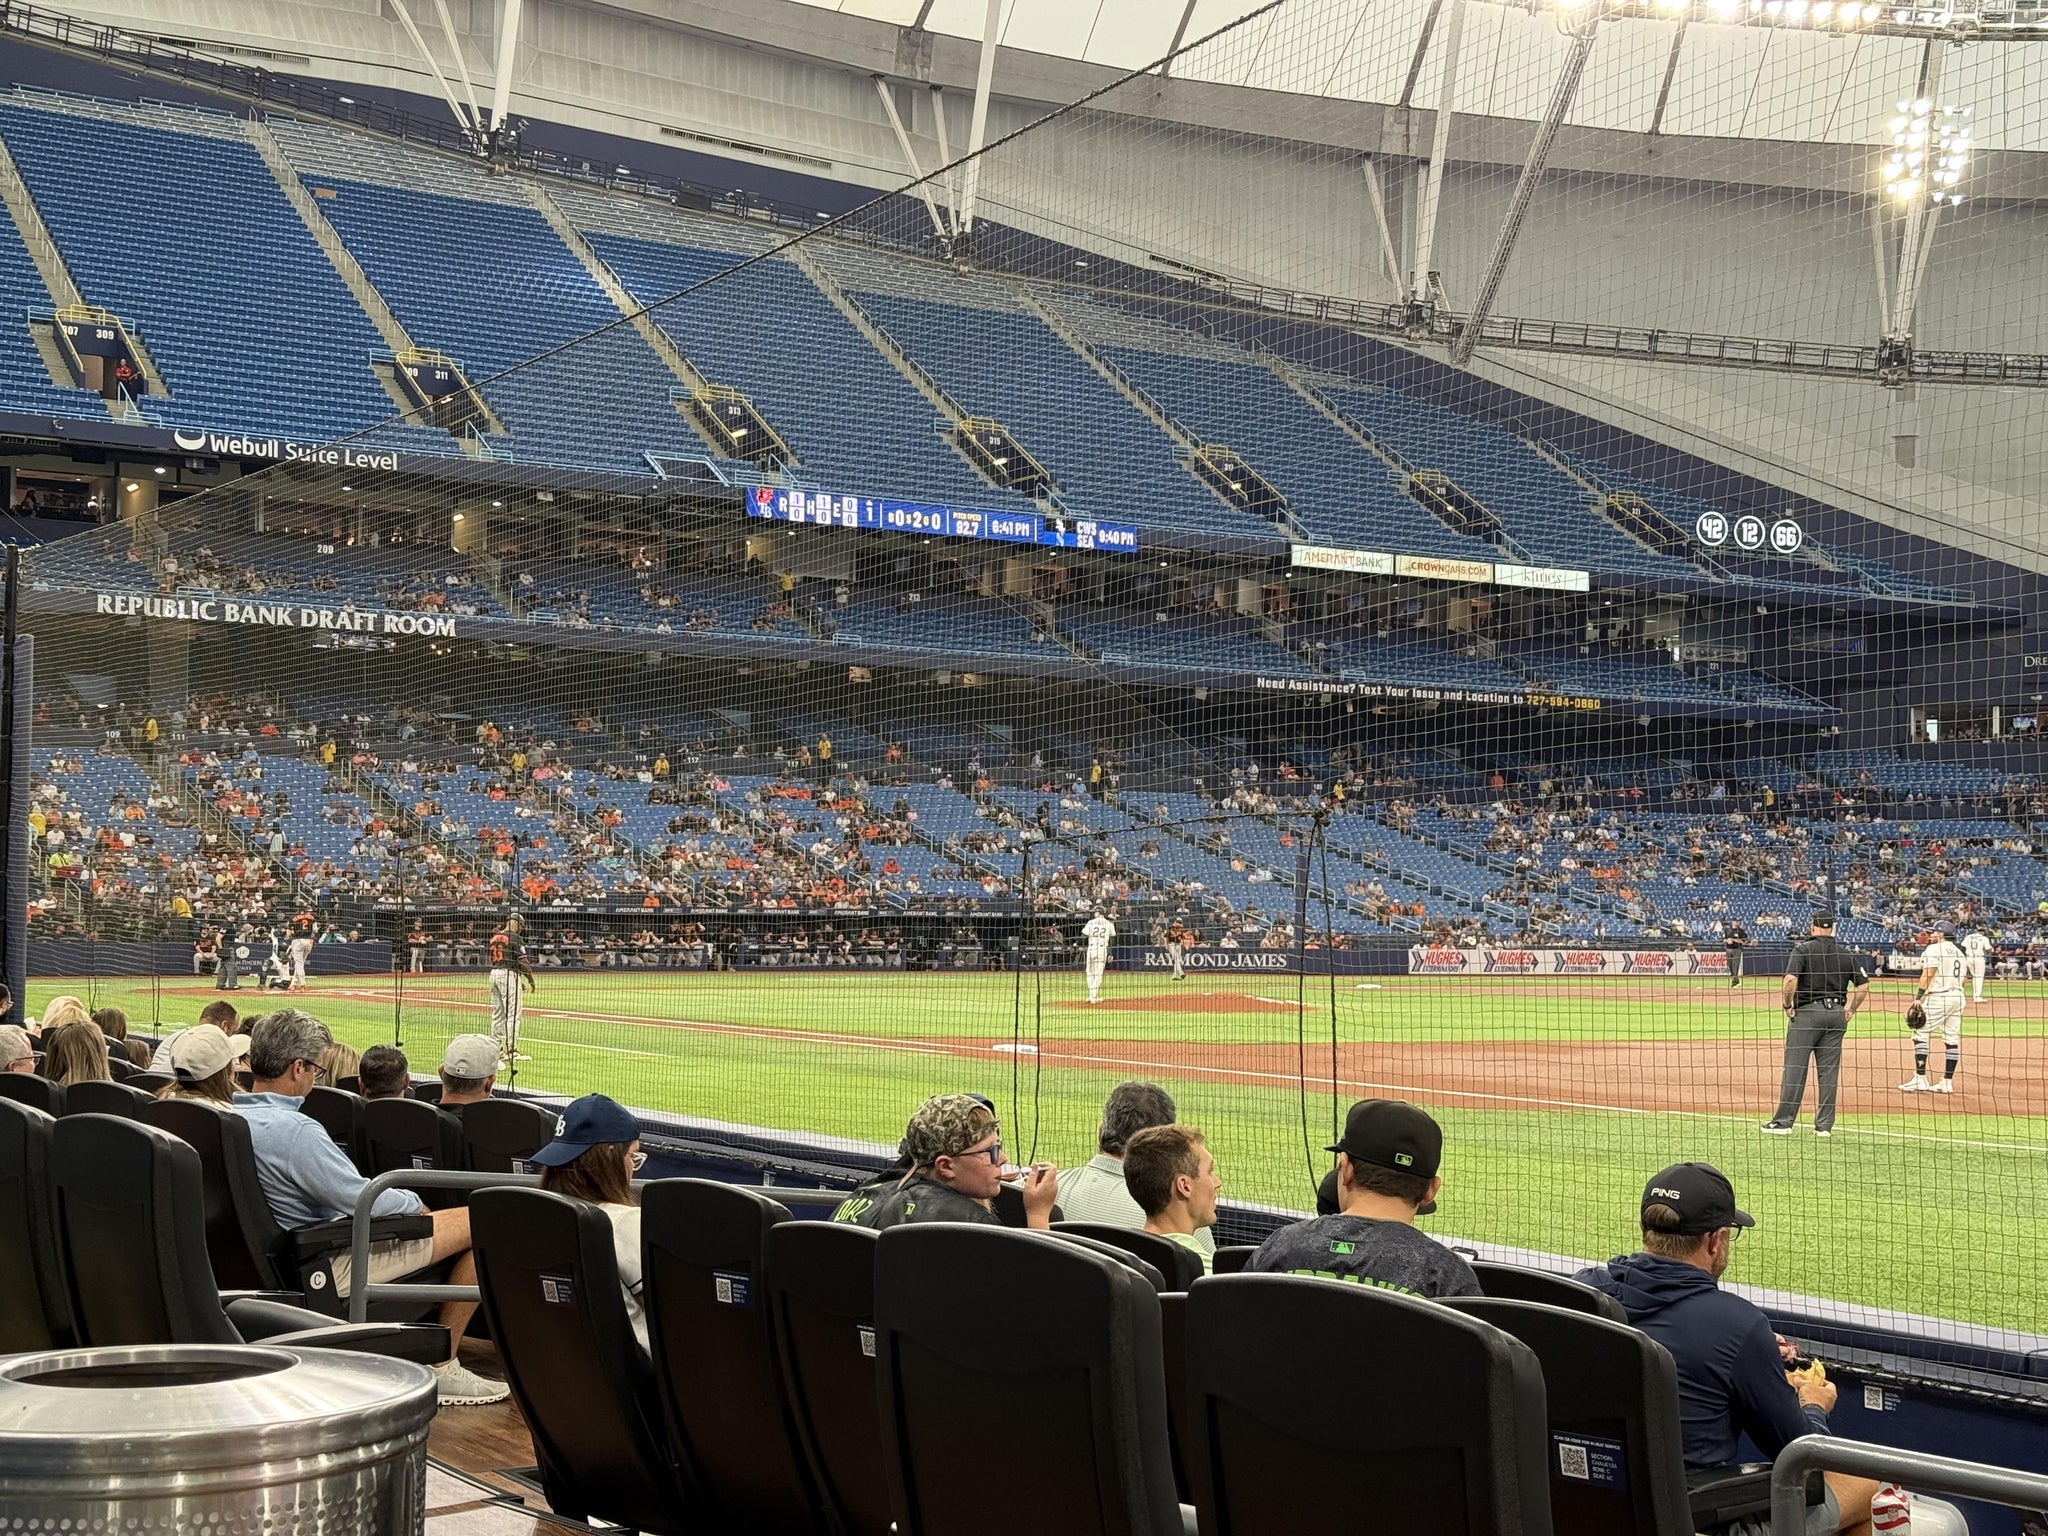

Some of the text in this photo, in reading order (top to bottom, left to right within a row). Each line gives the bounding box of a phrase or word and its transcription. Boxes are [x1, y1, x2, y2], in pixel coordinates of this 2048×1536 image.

[96, 328, 114, 340] 309
[435, 370, 448, 380] 311
[728, 406, 740, 416] 313
[210, 434, 398, 470] Webull Suite Level
[779, 497, 788, 512] R
[807, 500, 815, 515] H
[833, 503, 840, 517] E
[867, 507, 872, 521] 1
[895, 510, 904, 526] 0
[913, 511, 922, 528] 2
[932, 513, 940, 530] 0
[956, 521, 978, 535] 92.7
[992, 520, 1030, 536] 6:41 PM
[1077, 521, 1096, 535] CWS
[1702, 518, 1722, 538] 42
[1742, 522, 1758, 542] 12
[1077, 535, 1094, 548] SEA
[1100, 530, 1133, 546] 9:40 PM
[1776, 526, 1796, 546] 66
[1304, 551, 1381, 568] AMERANT BANK
[1411, 561, 1487, 576] CROWNCARS.COM
[96, 594, 457, 637] REPUBLIC BANK DRAFT ROOM
[1257, 678, 1285, 689] Need
[1288, 680, 1355, 694] Assistance?
[1360, 684, 1381, 695] Text
[1385, 686, 1409, 697] Your
[1412, 688, 1440, 698] Issue
[1444, 690, 1462, 701] and
[1466, 692, 1510, 704] Location
[1514, 694, 1523, 704] to
[296, 740, 309, 748] 111
[302, 920, 308, 930] 2
[1093, 927, 1106, 938] 22
[1144, 952, 1287, 967] RAYMOND JAMES
[1424, 951, 1461, 964] HUGHES
[1496, 952, 1533, 965] HUGHES
[1566, 952, 1601, 965] HUGHES
[1633, 953, 1668, 966] HUGHES
[1700, 954, 1727, 967] HUGHE
[1954, 960, 1960, 978] 8
[1651, 1188, 1680, 1200] PING
[314, 1274, 321, 1286] C
